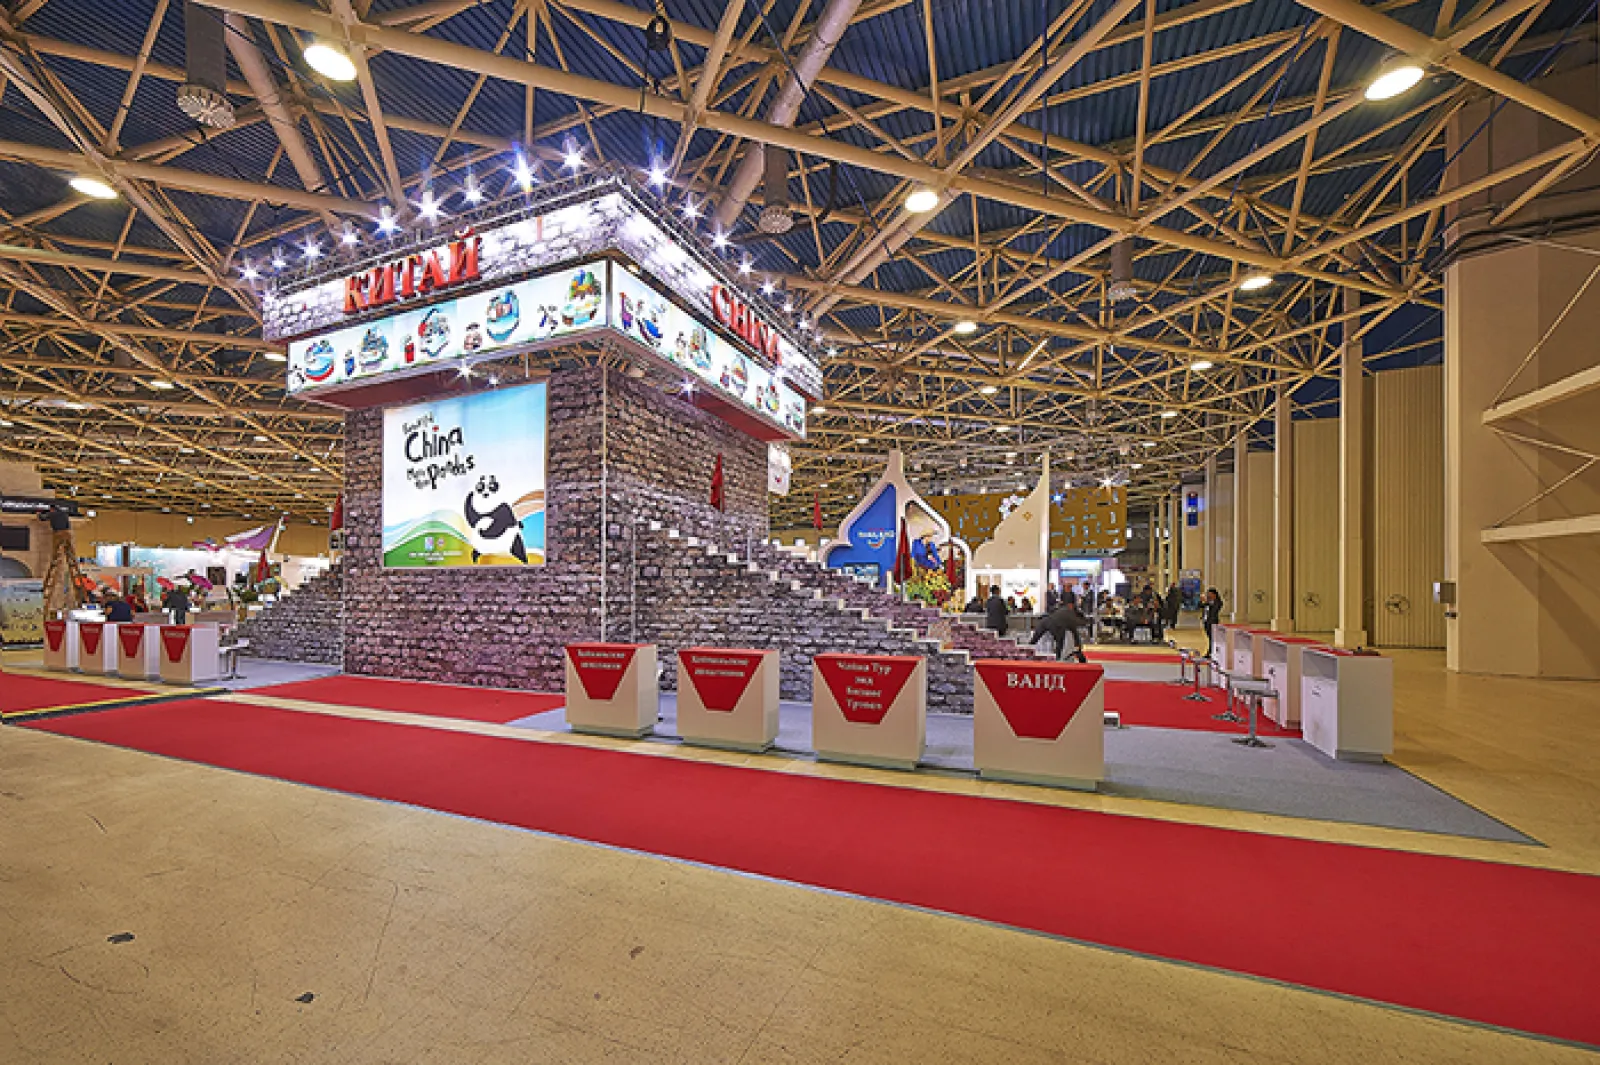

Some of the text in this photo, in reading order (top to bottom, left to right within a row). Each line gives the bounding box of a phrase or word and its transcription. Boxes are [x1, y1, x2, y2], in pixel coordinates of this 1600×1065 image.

[343, 226, 482, 314] КИТАЙ
[711, 284, 783, 367] CHINA
[404, 425, 463, 462] China
[871, 662, 892, 676] Тур
[1006, 672, 1067, 693] ВАНД
